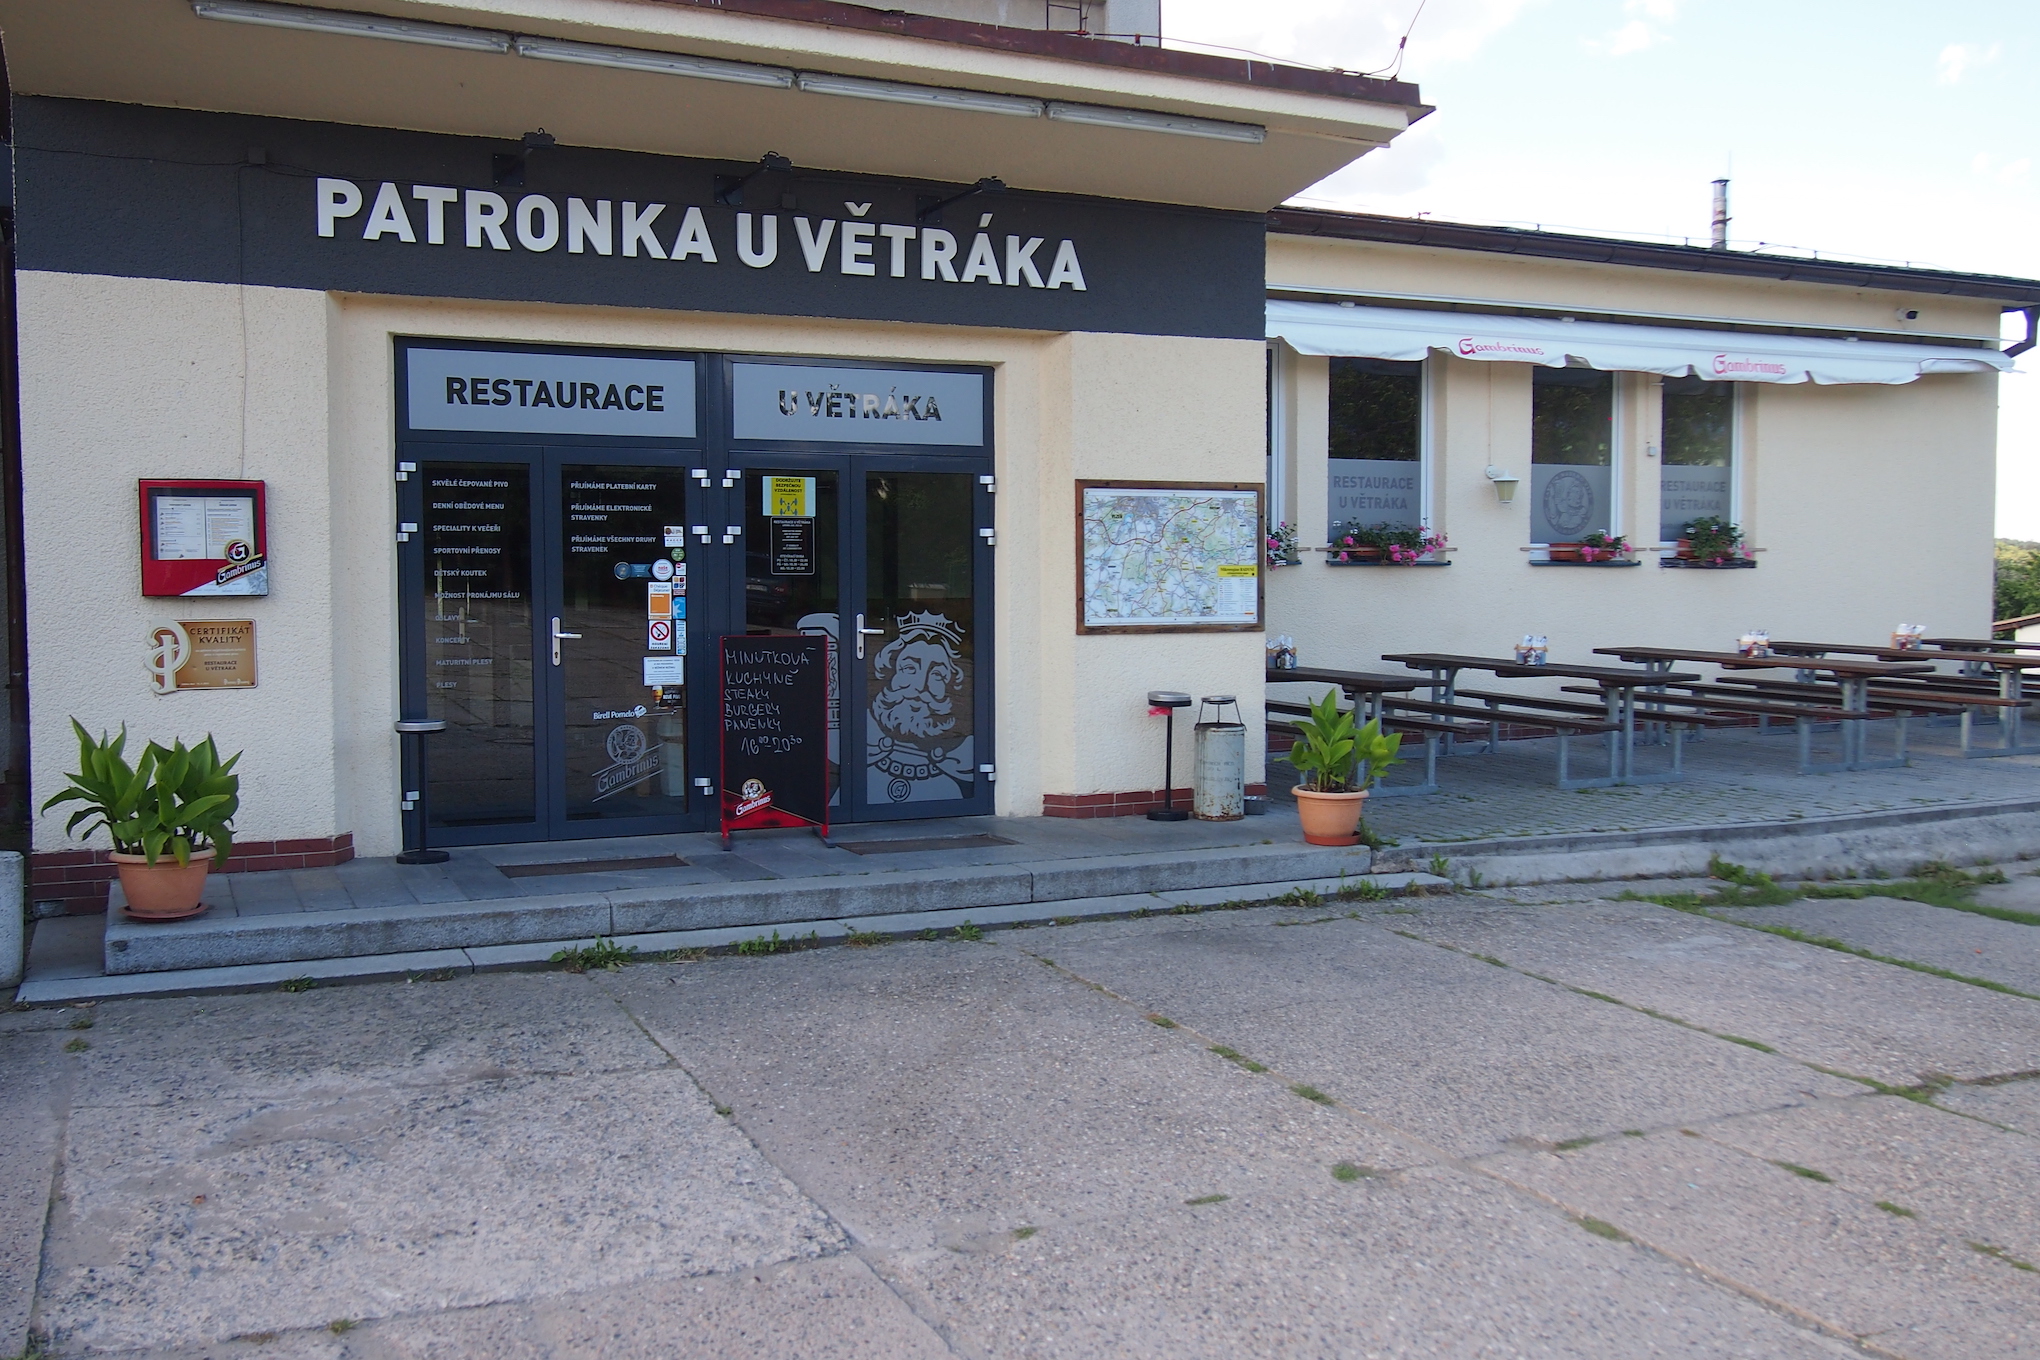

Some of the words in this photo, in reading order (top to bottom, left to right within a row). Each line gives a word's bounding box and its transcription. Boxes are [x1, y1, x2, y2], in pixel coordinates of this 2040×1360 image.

[316, 177, 717, 262] PATRONKA
[736, 212, 778, 268] U
[793, 201, 1087, 291] VĚTRÁKA
[1458, 338, 1545, 355] Gambrinus
[1712, 354, 1787, 375] Gambrinus
[446, 376, 664, 412] RESTAURACE
[778, 389, 797, 417] U
[806, 384, 942, 421] VĚTRÁKA
[432, 479, 458, 487] SKVĚLÉ
[459, 479, 493, 487] ČEPOVANÉ
[570, 481, 605, 489] PŘIJÍMÁME
[606, 482, 636, 490] PLATEBNÍ
[1333, 476, 1414, 490] RESTAURACE
[1661, 480, 1726, 492] RESTAURACE
[433, 501, 454, 509] DENNÍ
[454, 501, 485, 509] OBĚDOVÉ
[571, 503, 605, 511] PŘIJÍMÁME
[606, 504, 652, 512] ELEKTRONICKÉ
[1339, 496, 1347, 508] U
[1351, 493, 1408, 510] VĚTRÁKA
[1664, 500, 1670, 510] U
[477, 524, 501, 532] VEČEŘI
[571, 534, 606, 542] PŘIJÍMÁME
[433, 546, 470, 554] SPORTOVNÍ
[471, 546, 501, 554] PŘENOSY
[217, 560, 261, 583] Gambrinus
[434, 568, 460, 576] DĚTSKÝ
[190, 626, 250, 635] CERTIFIKÁT
[199, 636, 242, 644] KVALITY
[436, 658, 472, 666] MATURITNÍ
[725, 647, 816, 665] MINUTKOVÁ
[725, 669, 799, 685] KUCHYNĚ
[724, 688, 770, 701] STEAKY
[724, 702, 780, 717] BURGERY
[724, 717, 781, 732] PANENKY
[598, 755, 659, 793] Gambrinus
[735, 795, 771, 816] Gambrinus
